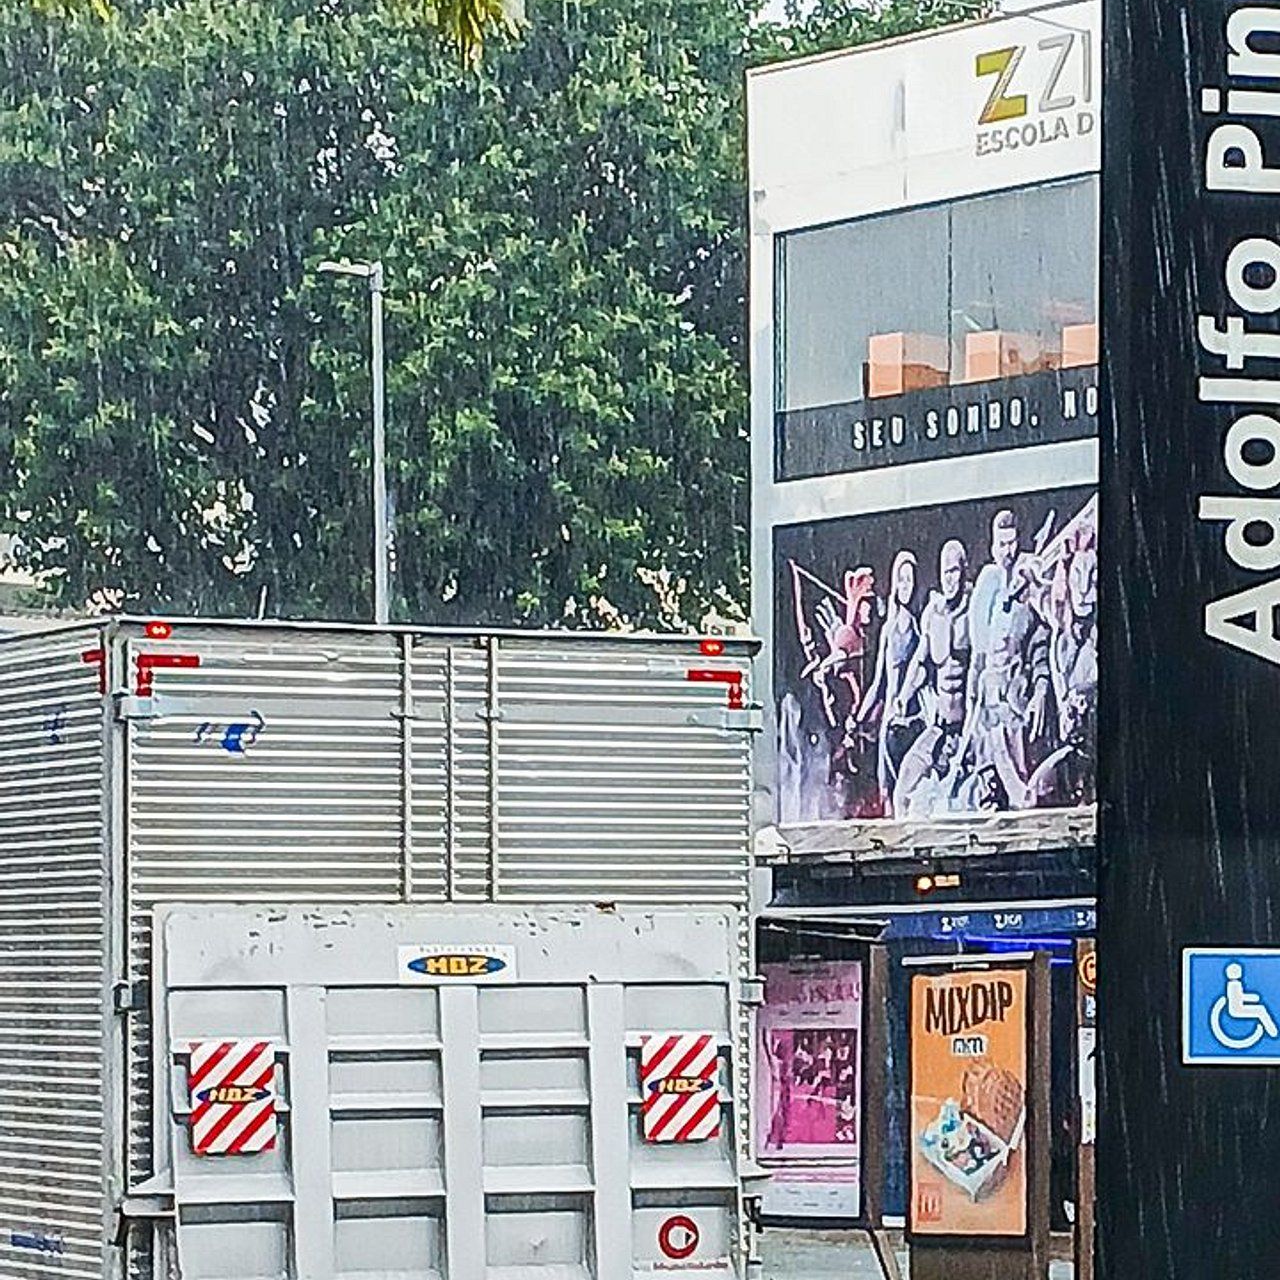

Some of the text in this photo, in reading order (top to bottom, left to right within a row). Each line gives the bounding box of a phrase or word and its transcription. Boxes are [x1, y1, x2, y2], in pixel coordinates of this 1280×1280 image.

[976, 112, 1094, 156] ESCOLA D
[853, 416, 904, 450] SEU
[1063, 386, 1098, 419] NO
[925, 981, 1013, 1036] MIXDIP
